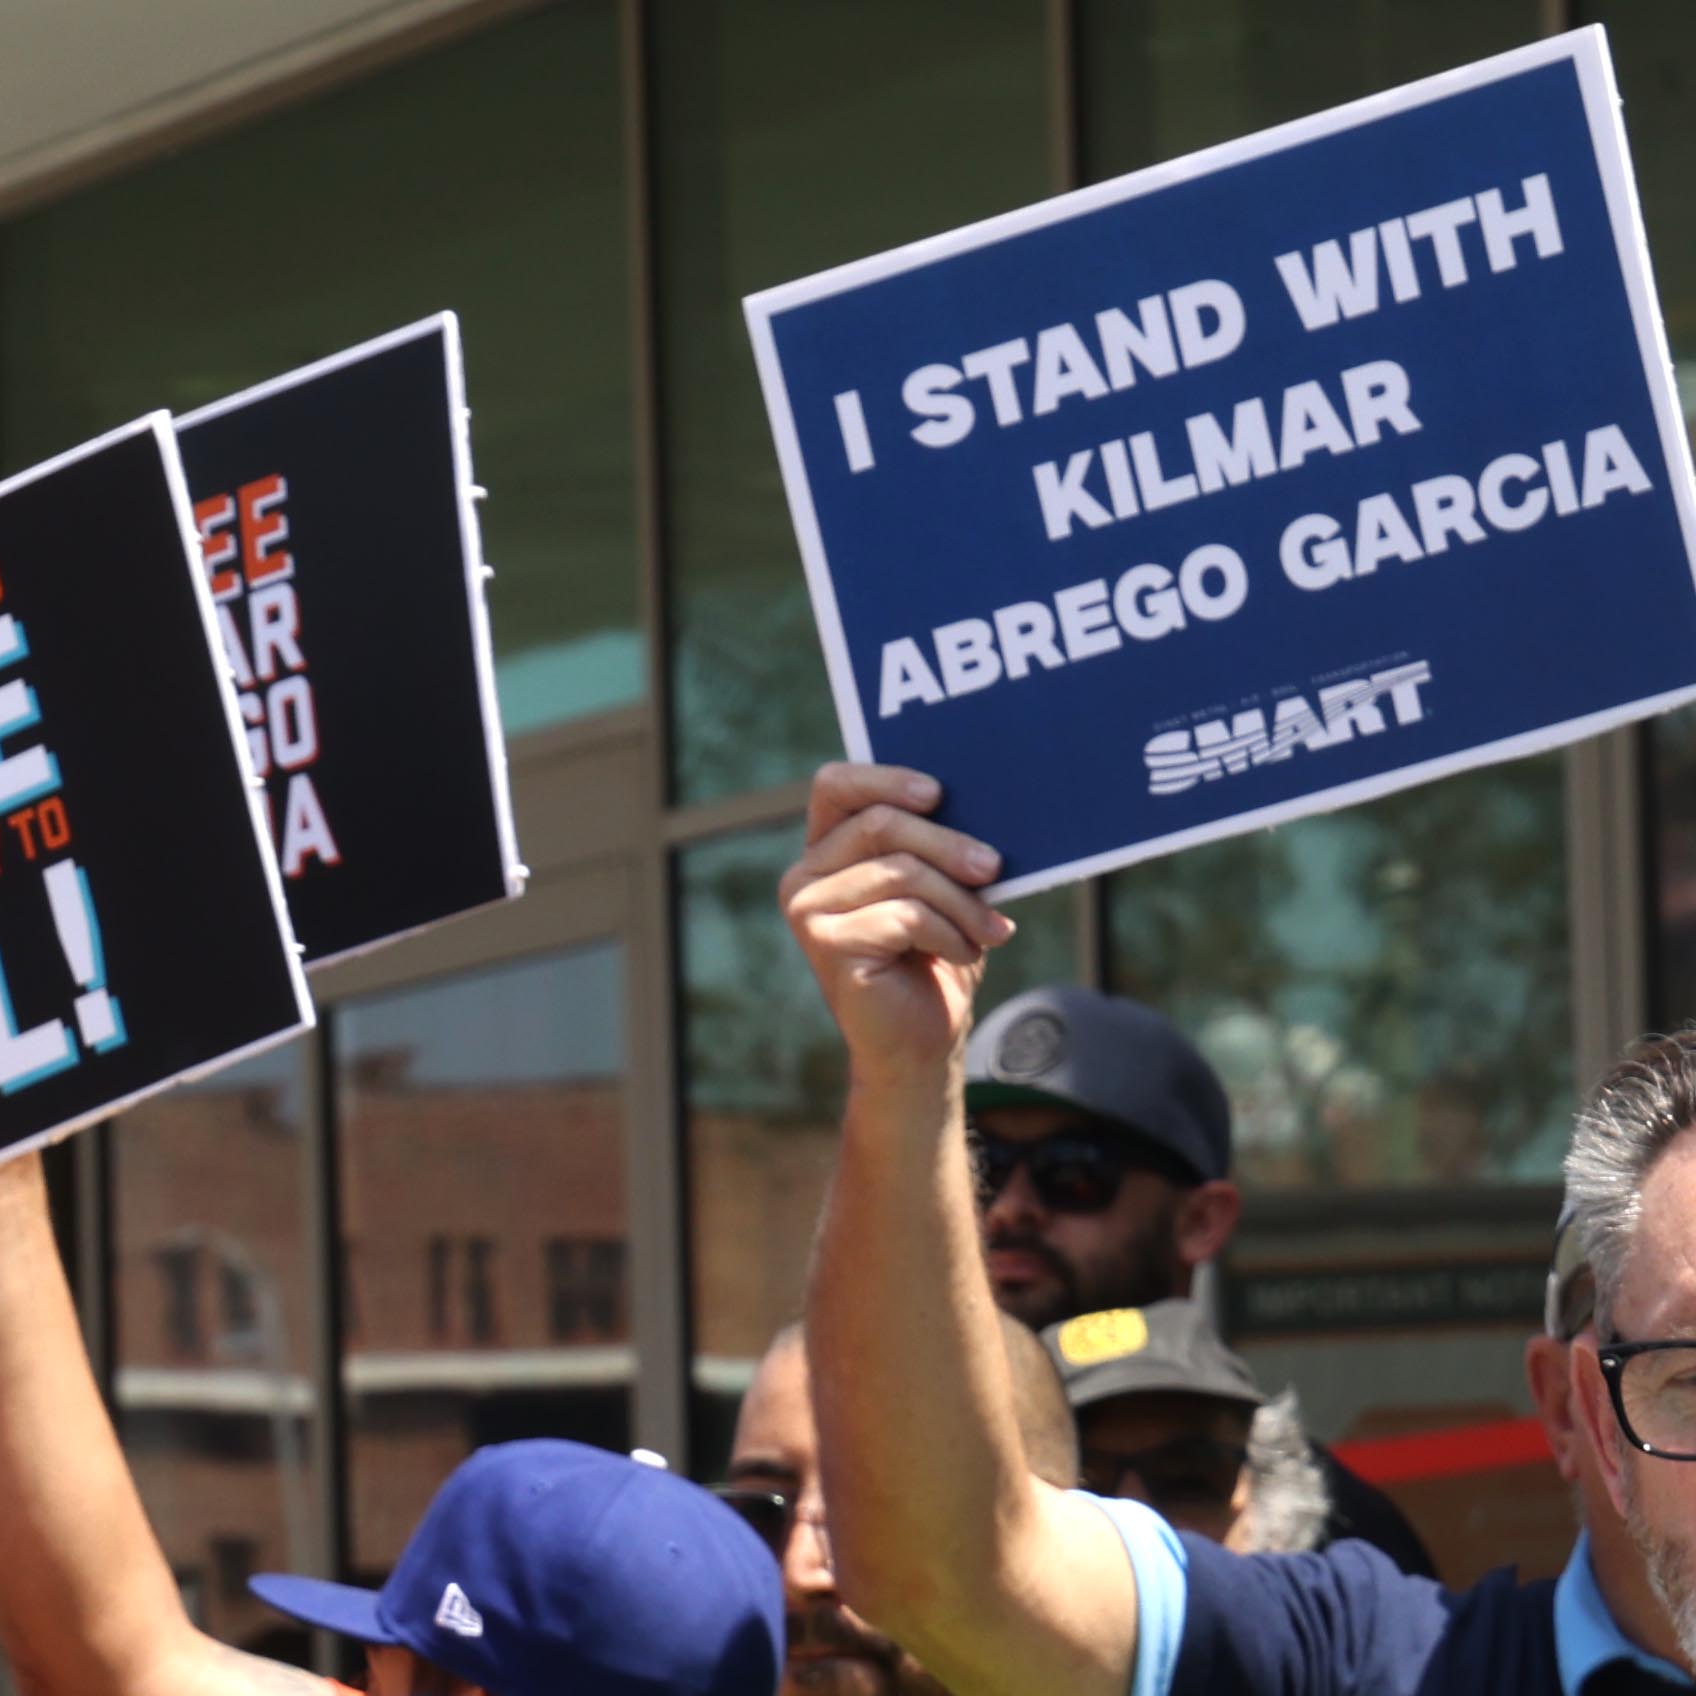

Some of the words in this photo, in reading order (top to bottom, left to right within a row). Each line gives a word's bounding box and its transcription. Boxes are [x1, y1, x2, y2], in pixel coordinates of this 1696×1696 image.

[834, 388, 877, 474] I
[901, 277, 1246, 449] STAND
[1274, 172, 1564, 334] WITH
[1033, 358, 1423, 543] KILMAR
[877, 543, 1248, 720] ABREGO
[1279, 422, 1652, 594] GARCIA
[1144, 659, 1433, 796] SMART
[11, 797, 72, 862] TO
